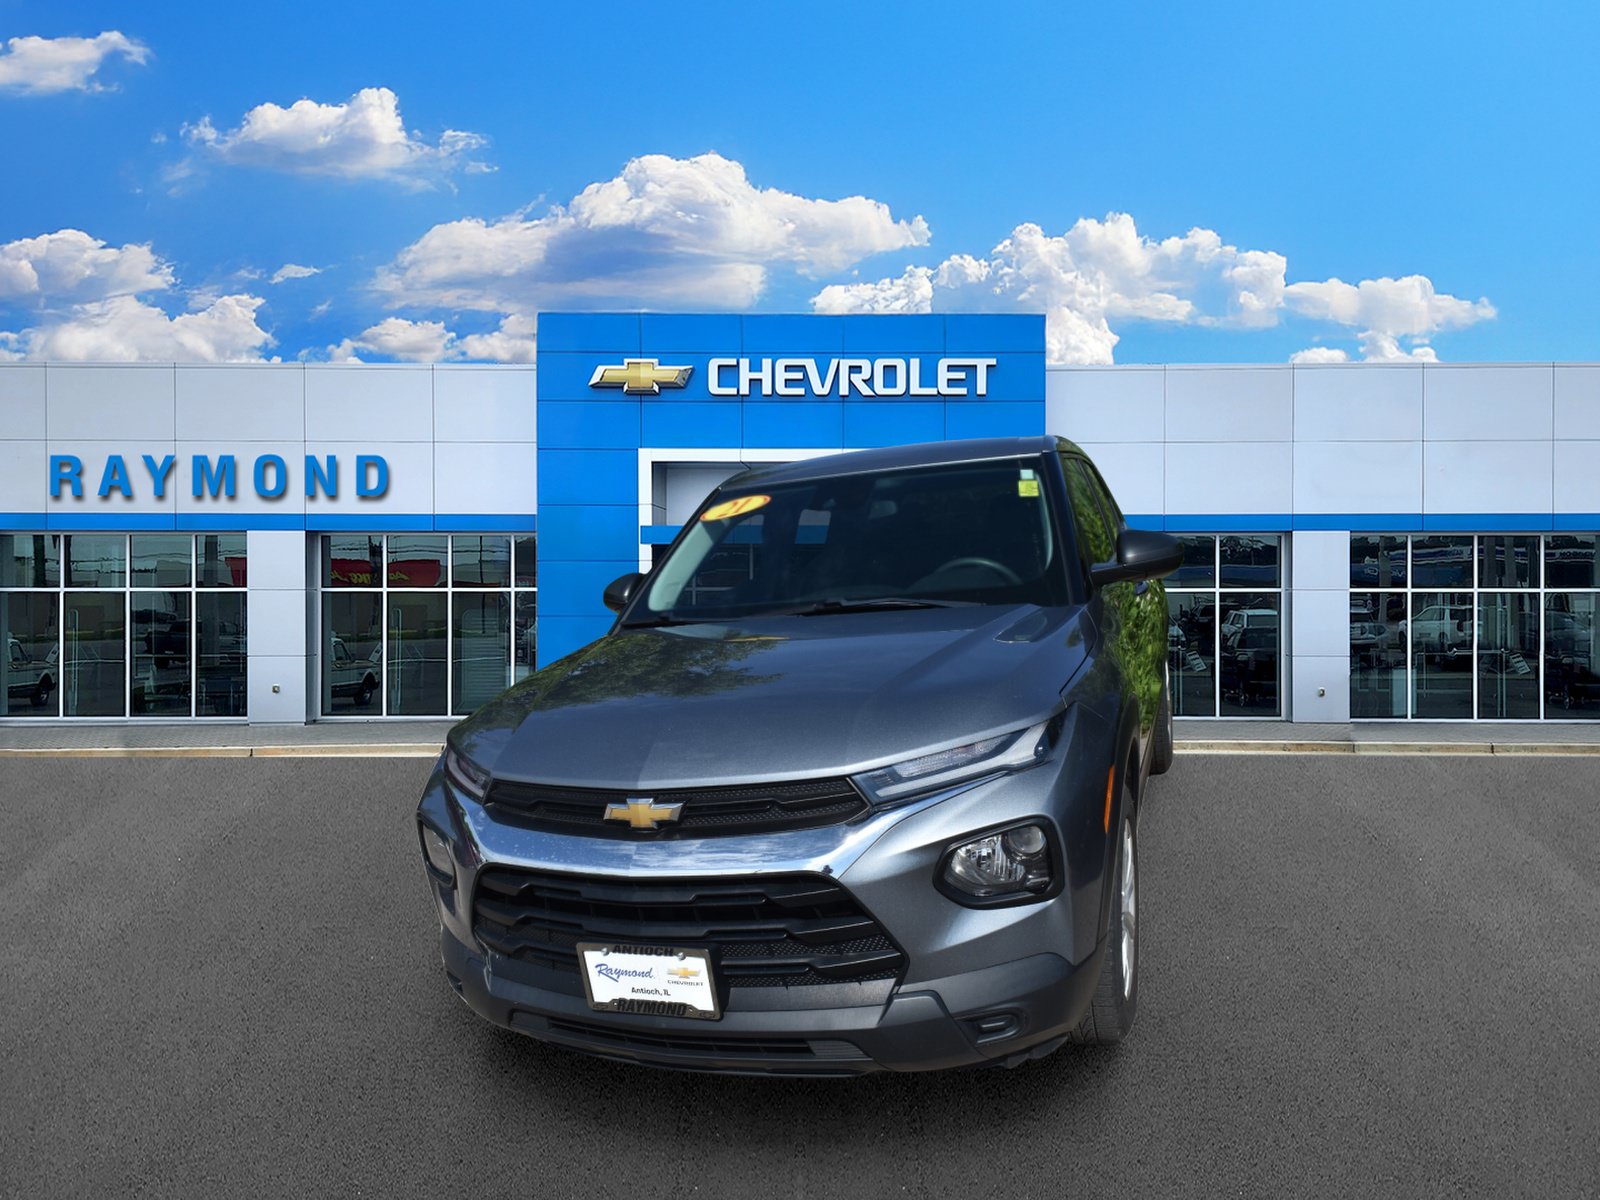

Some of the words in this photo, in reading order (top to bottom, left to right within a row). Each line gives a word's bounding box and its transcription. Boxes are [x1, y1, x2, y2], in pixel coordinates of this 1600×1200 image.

[708, 358, 997, 396] CHEVROLET
[49, 454, 391, 498] RAYMOND
[612, 944, 675, 957] ANTIOCH
[595, 963, 656, 982] Raymond
[631, 986, 663, 996] Antioch,
[617, 997, 688, 1017] RAYMOND
